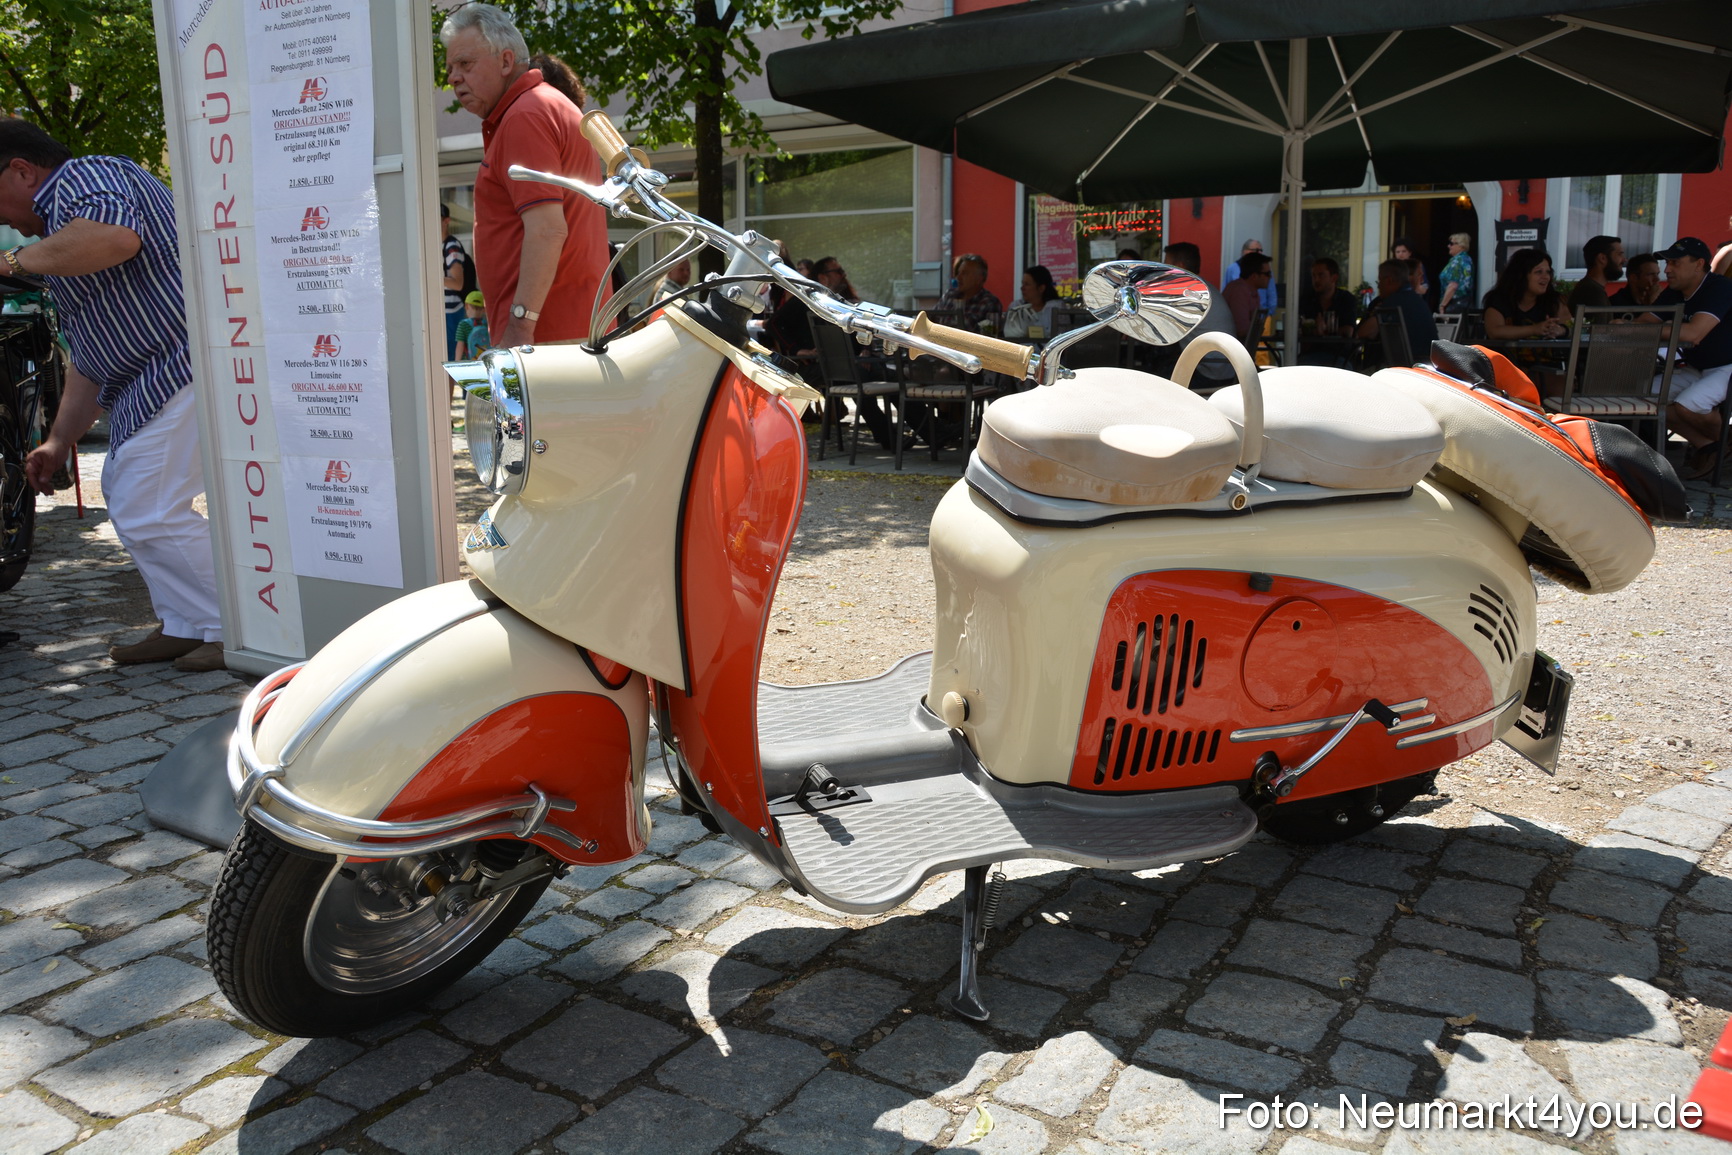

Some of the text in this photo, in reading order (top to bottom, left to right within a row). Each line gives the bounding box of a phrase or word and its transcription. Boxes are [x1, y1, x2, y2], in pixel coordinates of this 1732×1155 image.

[281, 4, 332, 20] Seit über 30 Jahren
[273, 16, 317, 31] Automobilpartner
[325, 12, 351, 22] Nürnberg
[298, 38, 311, 48] 0175
[298, 49, 310, 58] 0911
[312, 46, 332, 56] 499999
[270, 60, 315, 73] Regensburgerstr.
[324, 54, 350, 64] Nürnberg
[272, 98, 354, 117] Mercedes-Benz 250S W108
[274, 111, 351, 130] ORIGINALZUSTAND!!!
[275, 124, 350, 141] Erstzulassung 04.08.1967
[284, 138, 340, 152] original 68.310 Km
[292, 151, 330, 163] sehr gepflegt
[314, 175, 334, 185] EURO
[271, 233, 316, 244] Mercedes-Benz
[317, 232, 328, 240] 380
[340, 229, 360, 238] W126
[292, 243, 341, 254] in Bestzustand!!
[283, 256, 319, 267] ORIGINAL
[342, 254, 353, 263] km
[287, 268, 329, 278] Erstzulassung
[296, 280, 343, 291] AUTOMATIC!
[322, 304, 344, 313] EURO
[284, 359, 368, 368] Mercedes-Benz W 116 280 S
[310, 371, 342, 379] Limousine
[291, 383, 326, 392] ORIGINAL
[348, 383, 363, 392] KM!
[297, 394, 358, 404] Erstzulassung 2/1974
[306, 406, 351, 416] AUTOMATIC!
[333, 430, 353, 439] EURO
[306, 482, 370, 494] Mercedes-Benz 350 SE
[344, 497, 355, 506] km
[318, 506, 362, 517] H-Kennzeichen!
[311, 516, 348, 529] Erstzulassung
[327, 530, 356, 540] Automatic
[344, 553, 363, 564] EURO
